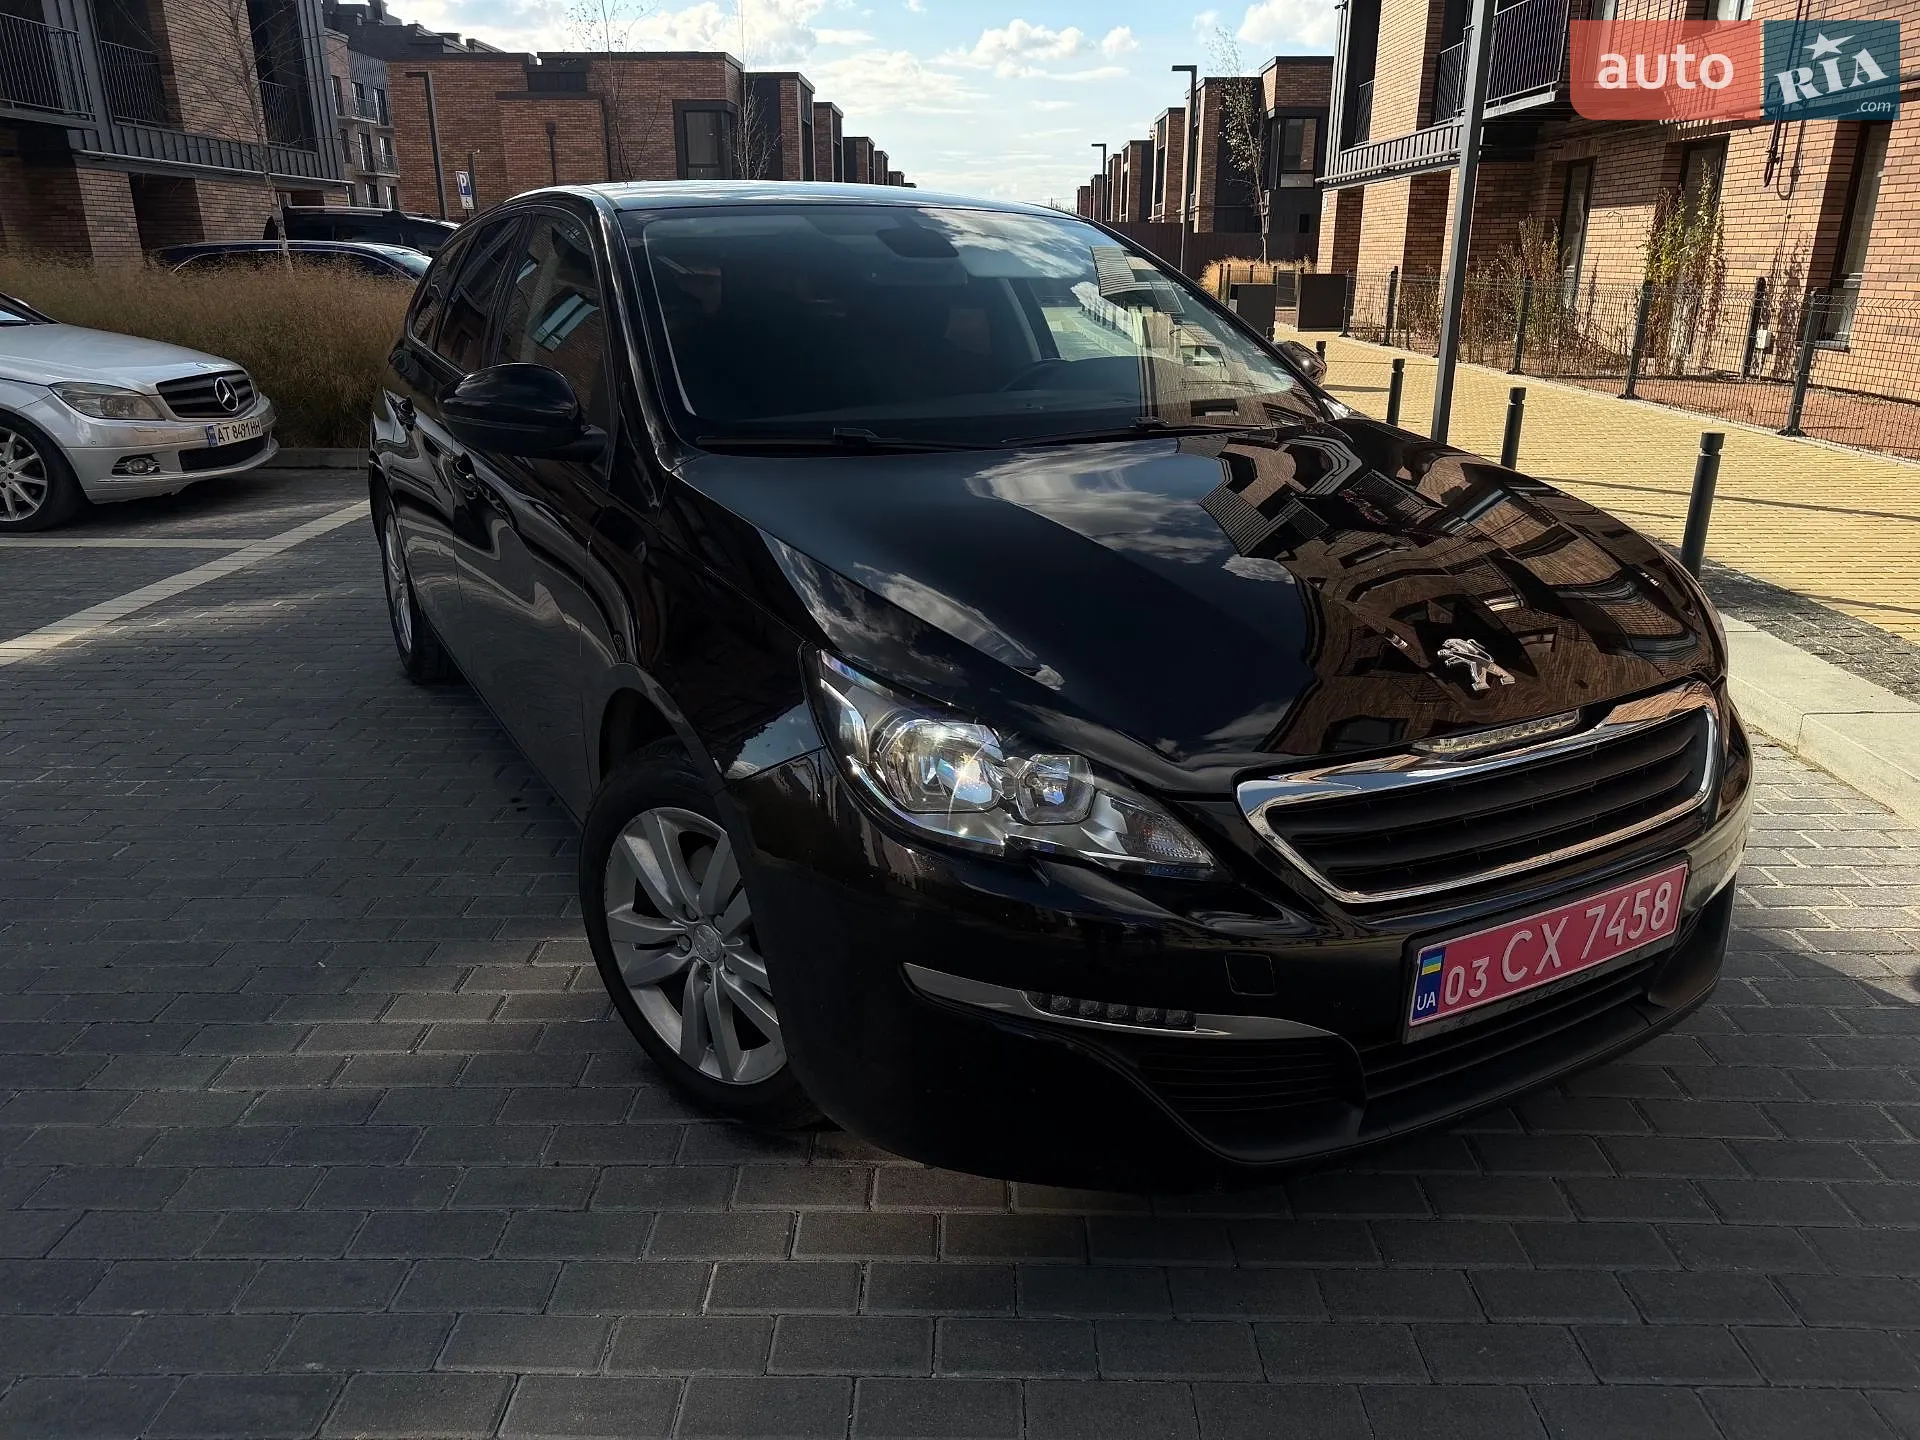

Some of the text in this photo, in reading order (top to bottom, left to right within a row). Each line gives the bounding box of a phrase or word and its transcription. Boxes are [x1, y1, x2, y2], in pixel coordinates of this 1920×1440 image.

[460, 174, 467, 194] P
[218, 427, 230, 442] AT
[1445, 956, 1490, 1005] 03
[1502, 917, 1568, 983] CX
[1581, 882, 1672, 960] 7458
[1416, 991, 1436, 1011] UA
